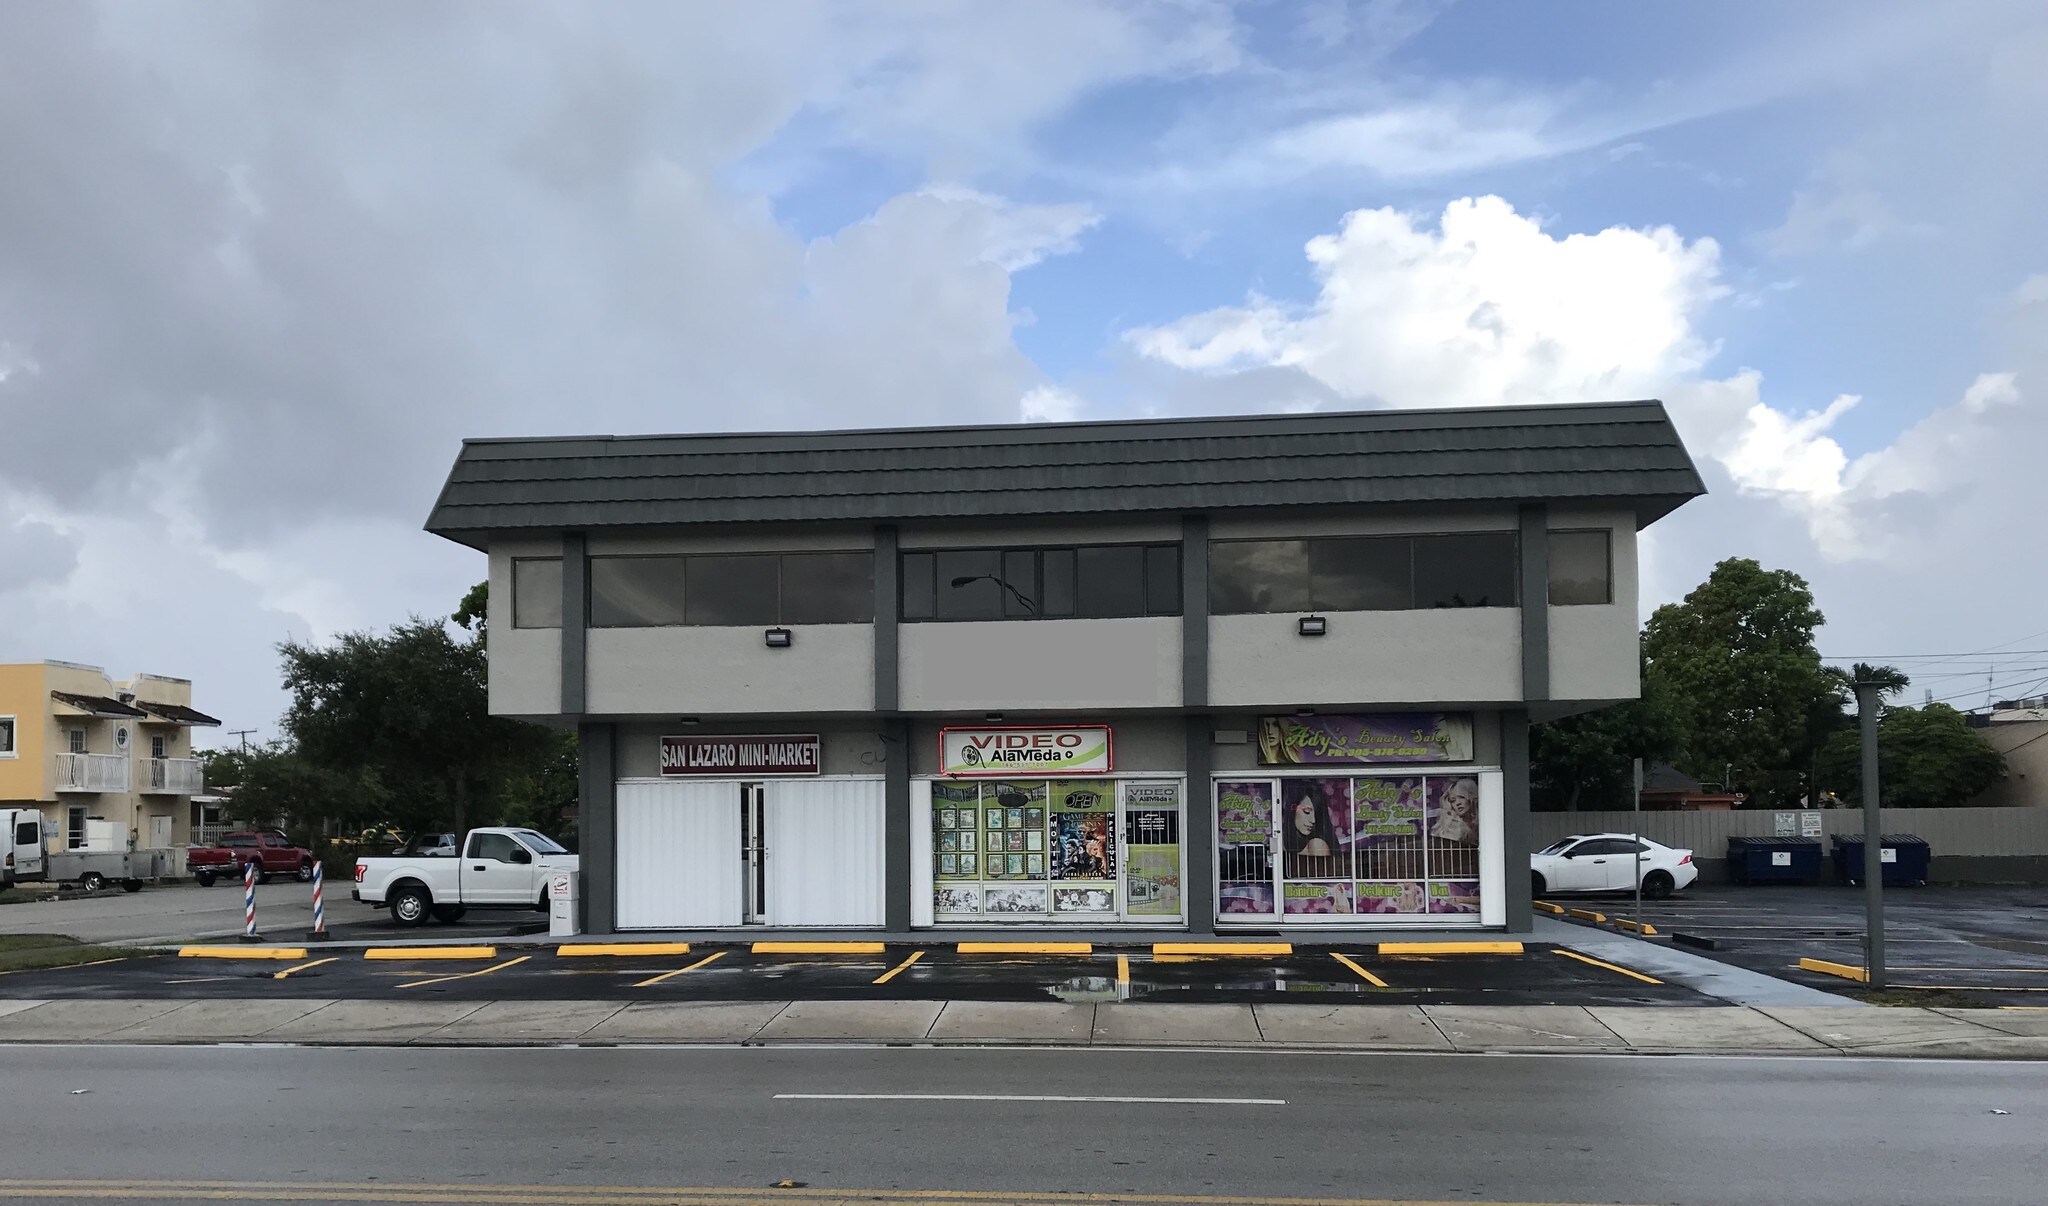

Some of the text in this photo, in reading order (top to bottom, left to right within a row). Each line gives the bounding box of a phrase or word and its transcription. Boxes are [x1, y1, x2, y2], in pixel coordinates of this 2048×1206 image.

[969, 734, 1082, 749] VIDEO
[1285, 725, 1450, 756] Ady's Beauty Salon
[662, 743, 818, 767] SAN LAZARO MINI-MARKET
[1064, 794, 1102, 807] OPEN
[1358, 883, 1402, 897] Pedicure
